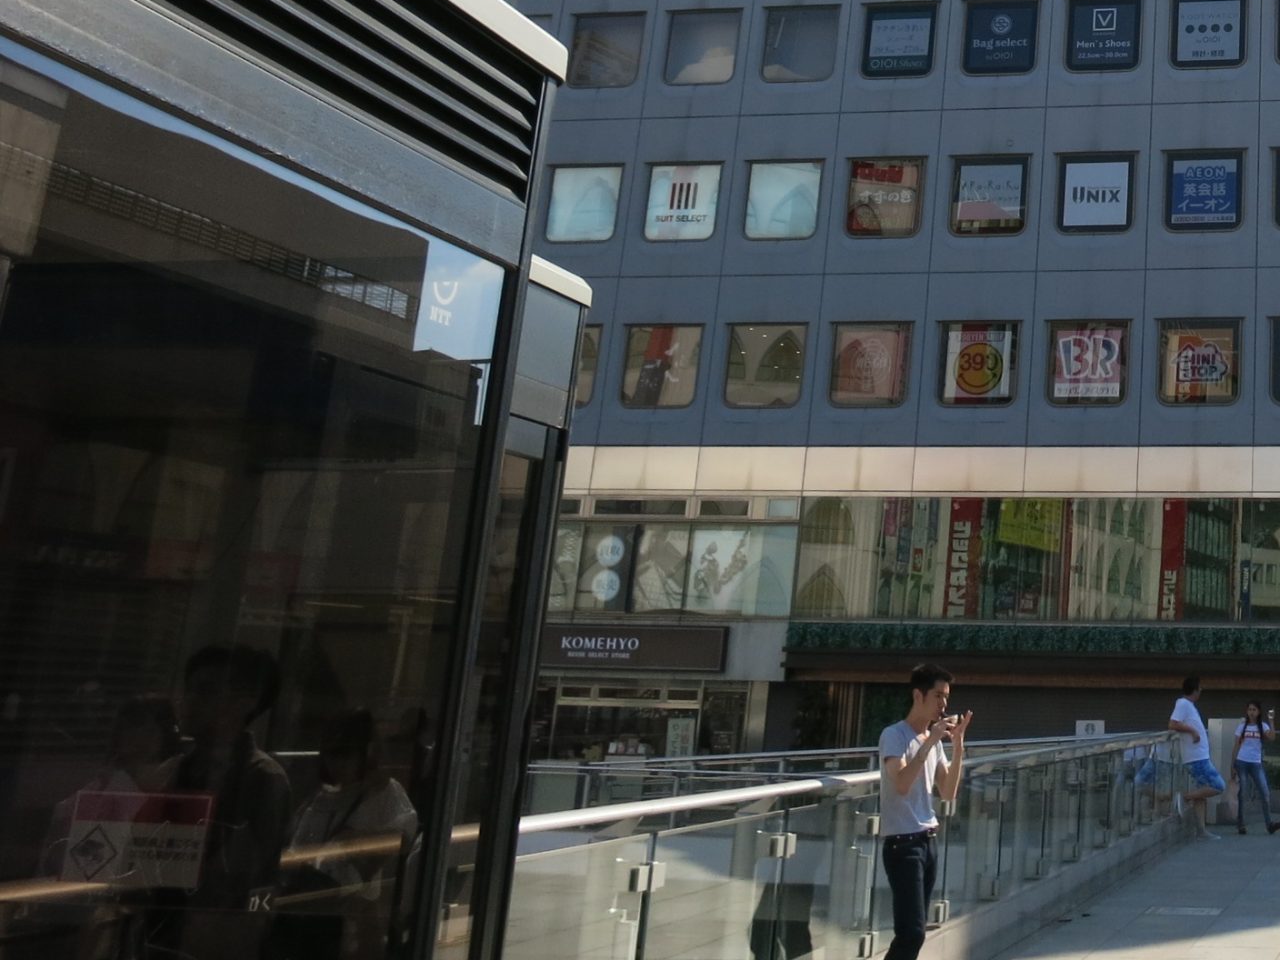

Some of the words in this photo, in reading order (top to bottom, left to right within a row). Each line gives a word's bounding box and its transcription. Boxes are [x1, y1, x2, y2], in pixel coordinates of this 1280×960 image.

[972, 38, 994, 50] Bag
[995, 37, 1028, 47] select
[1105, 39, 1131, 48] Shoes
[1184, 167, 1226, 179] AEON
[1072, 186, 1121, 203] UNIX
[1183, 182, 1227, 197] 英会話
[1177, 199, 1231, 212] イーオン
[655, 214, 673, 223] SUIT
[676, 214, 708, 223] SELECT
[561, 636, 640, 651] KOMEHYO
